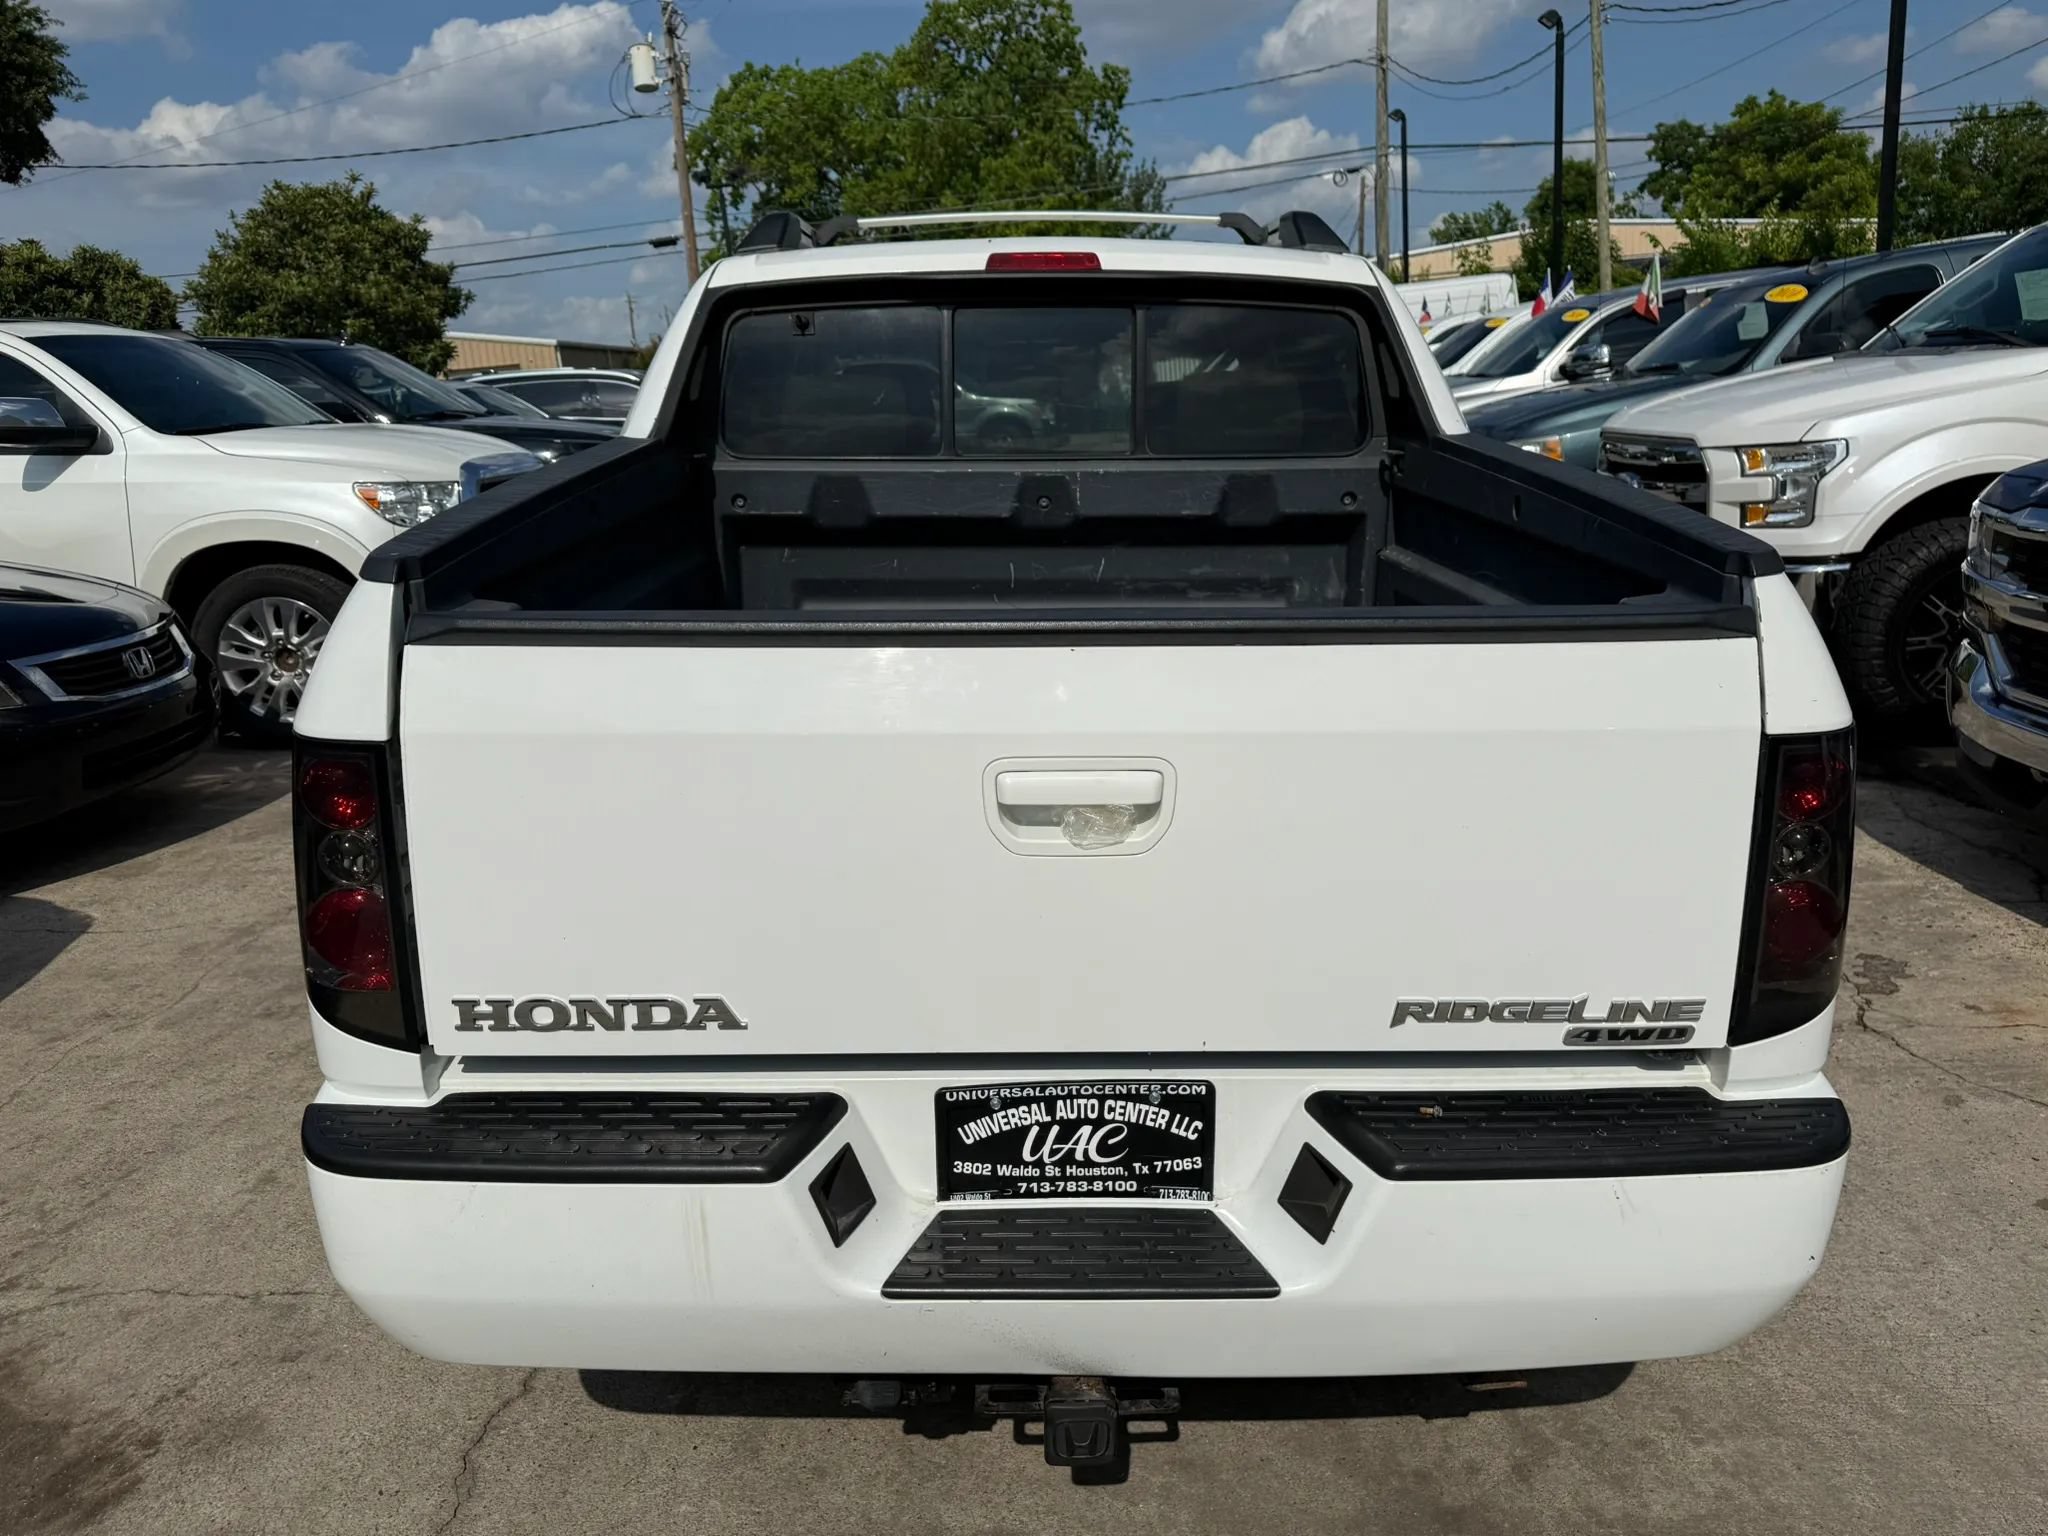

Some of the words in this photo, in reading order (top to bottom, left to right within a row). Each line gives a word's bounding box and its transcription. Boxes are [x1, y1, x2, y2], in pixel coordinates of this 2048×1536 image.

[451, 993, 749, 1033] HONDA
[1389, 993, 1707, 1029] RIDGELINE
[1567, 1026, 1687, 1042] 4WD
[945, 1084, 1207, 1101] UNIVERSALAUTOCENTER.COM
[957, 1102, 1052, 1145] UNIVERSAL
[1055, 1098, 1099, 1120] AUTO
[1103, 1098, 1171, 1130] CENTER
[1170, 1111, 1204, 1141] LLC
[1021, 1123, 1129, 1164] UAC
[953, 1160, 992, 1176] 3802
[996, 1164, 1041, 1177] Waldo
[1045, 1165, 1061, 1177] St
[1066, 1164, 1128, 1178] Houston,
[1133, 1162, 1149, 1175] Tx
[1153, 1156, 1203, 1174] 77063
[1017, 1180, 1138, 1194] 713-783-8100
